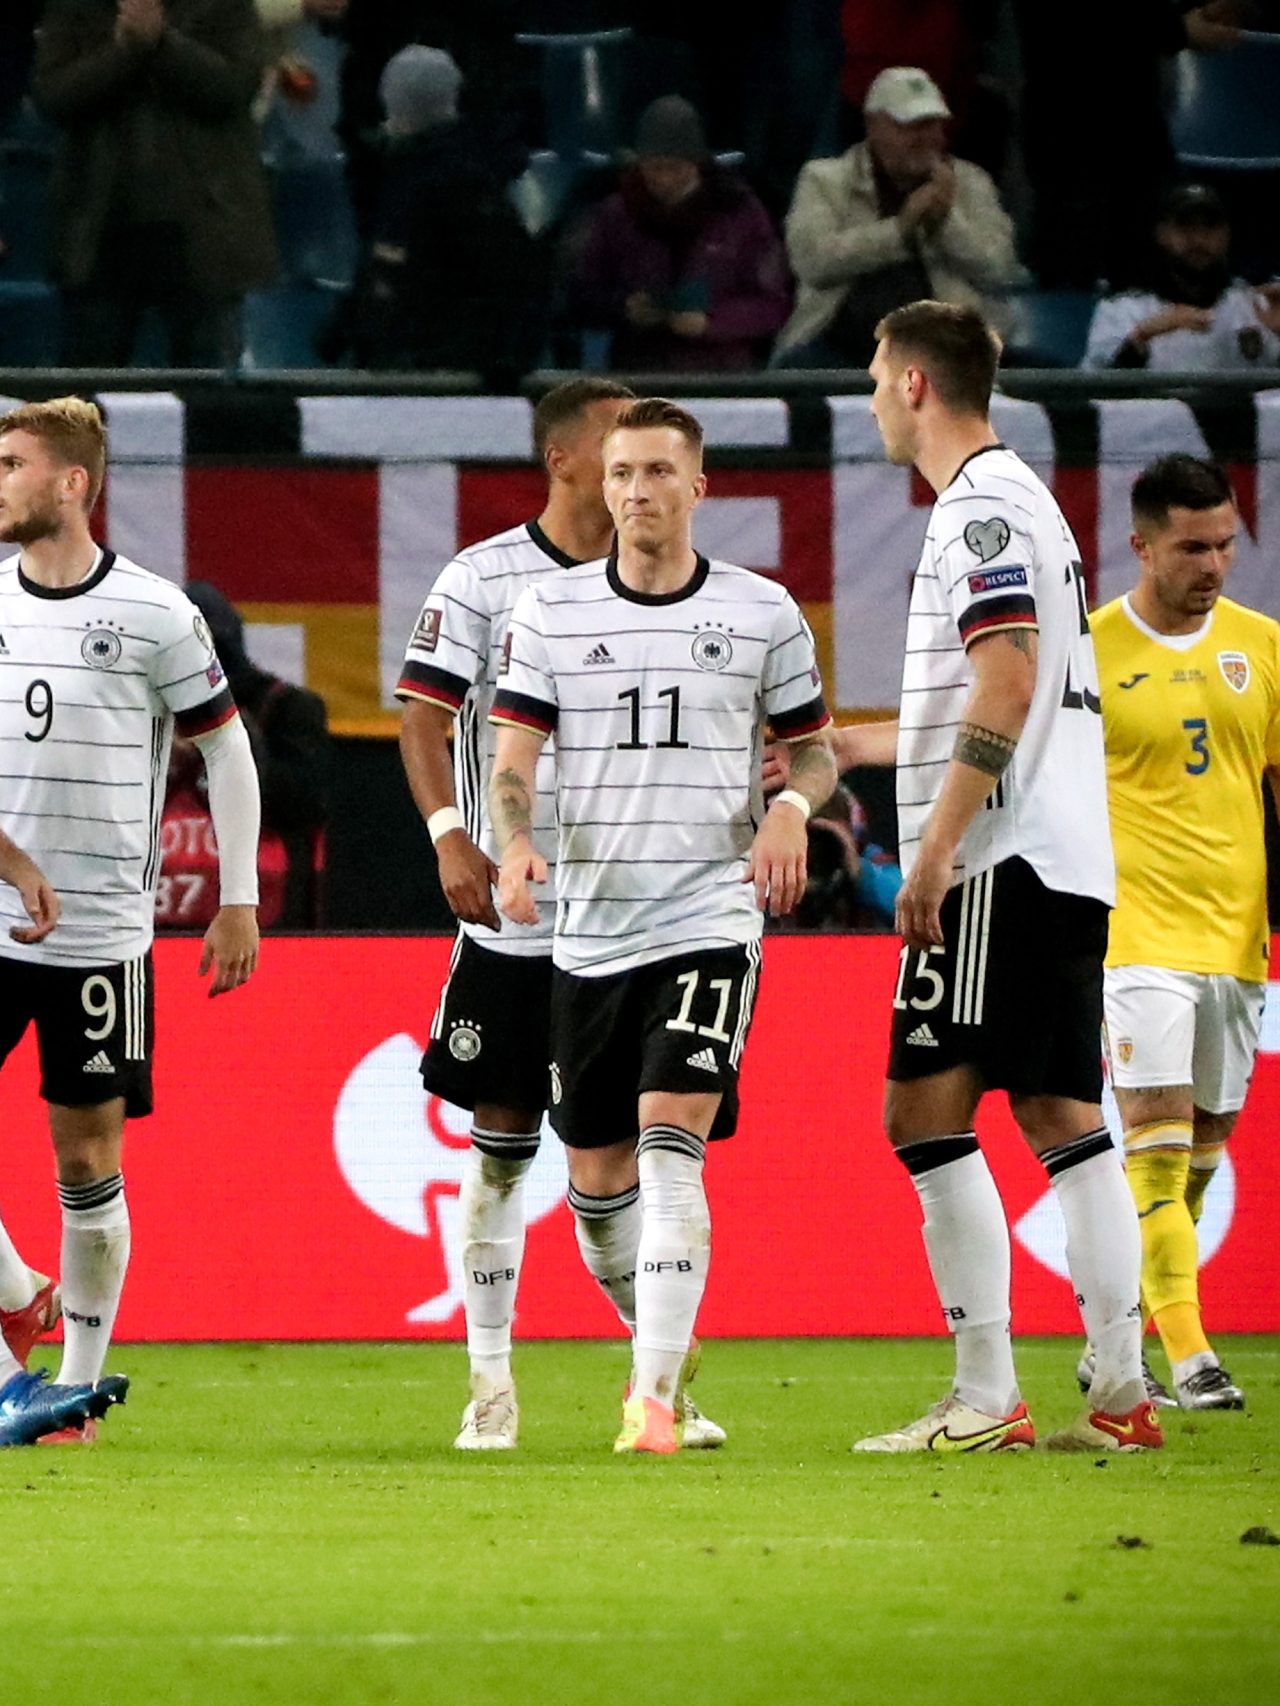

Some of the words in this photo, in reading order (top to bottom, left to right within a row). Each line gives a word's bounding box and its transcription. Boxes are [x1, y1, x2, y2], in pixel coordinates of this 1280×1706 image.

[985, 570, 1025, 586] RESPECT
[24, 679, 53, 743] 9
[616, 685, 689, 749] 11
[1182, 717, 1210, 775] 3
[81, 974, 116, 1041] 9
[665, 969, 732, 1043] 11
[892, 944, 946, 1011] 15
[473, 1268, 515, 1286] DFB
[643, 1259, 693, 1273] DFB
